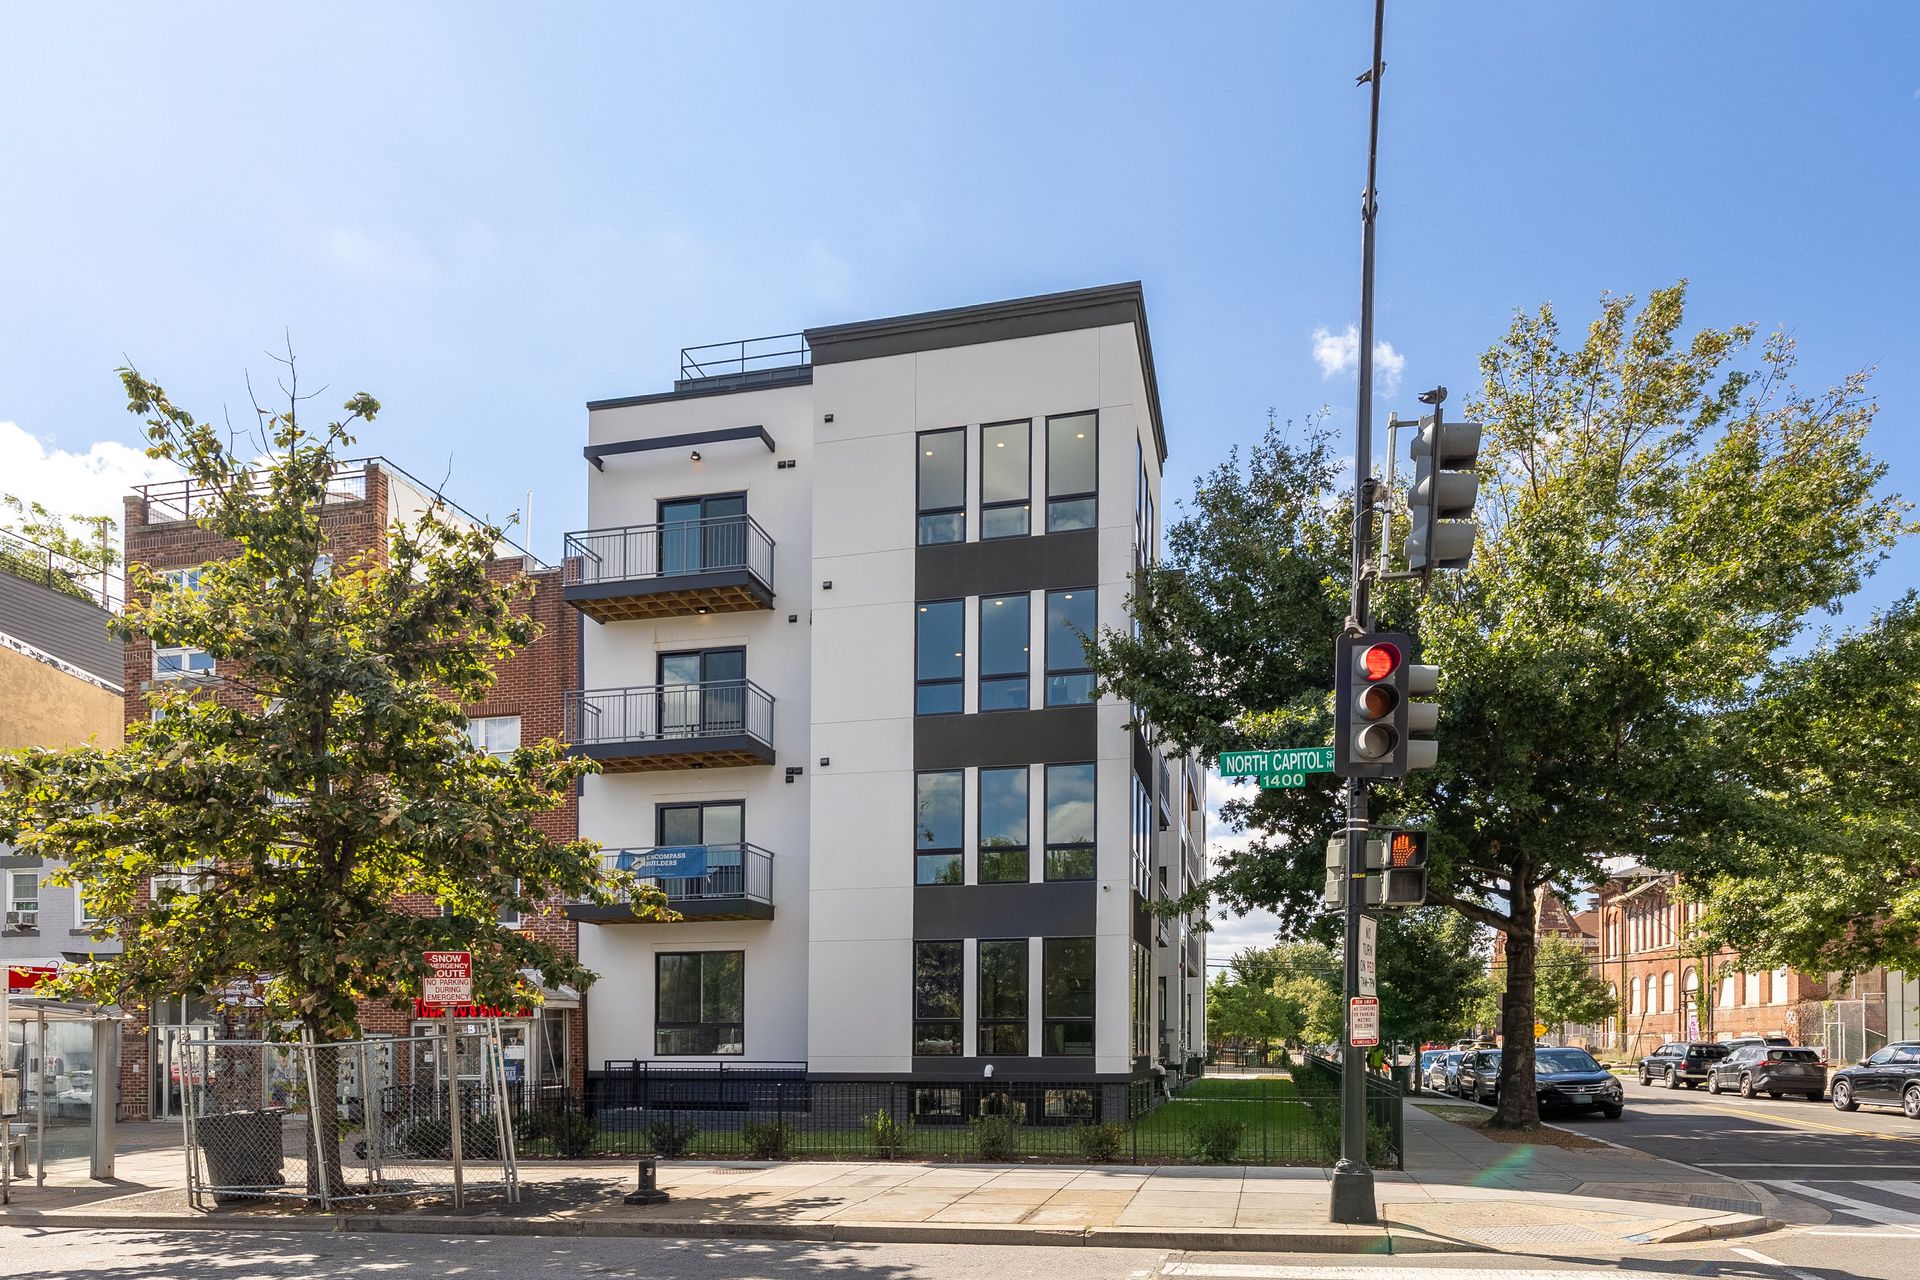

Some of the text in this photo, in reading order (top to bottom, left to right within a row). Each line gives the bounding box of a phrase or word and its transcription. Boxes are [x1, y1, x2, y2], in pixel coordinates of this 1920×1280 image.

[1226, 751, 1323, 773] NORTH CAPITOL
[1263, 773, 1304, 787] 1400
[431, 954, 462, 963] SNOW
[434, 969, 466, 977] OUTE
[427, 993, 470, 1001] EMERGENCY
